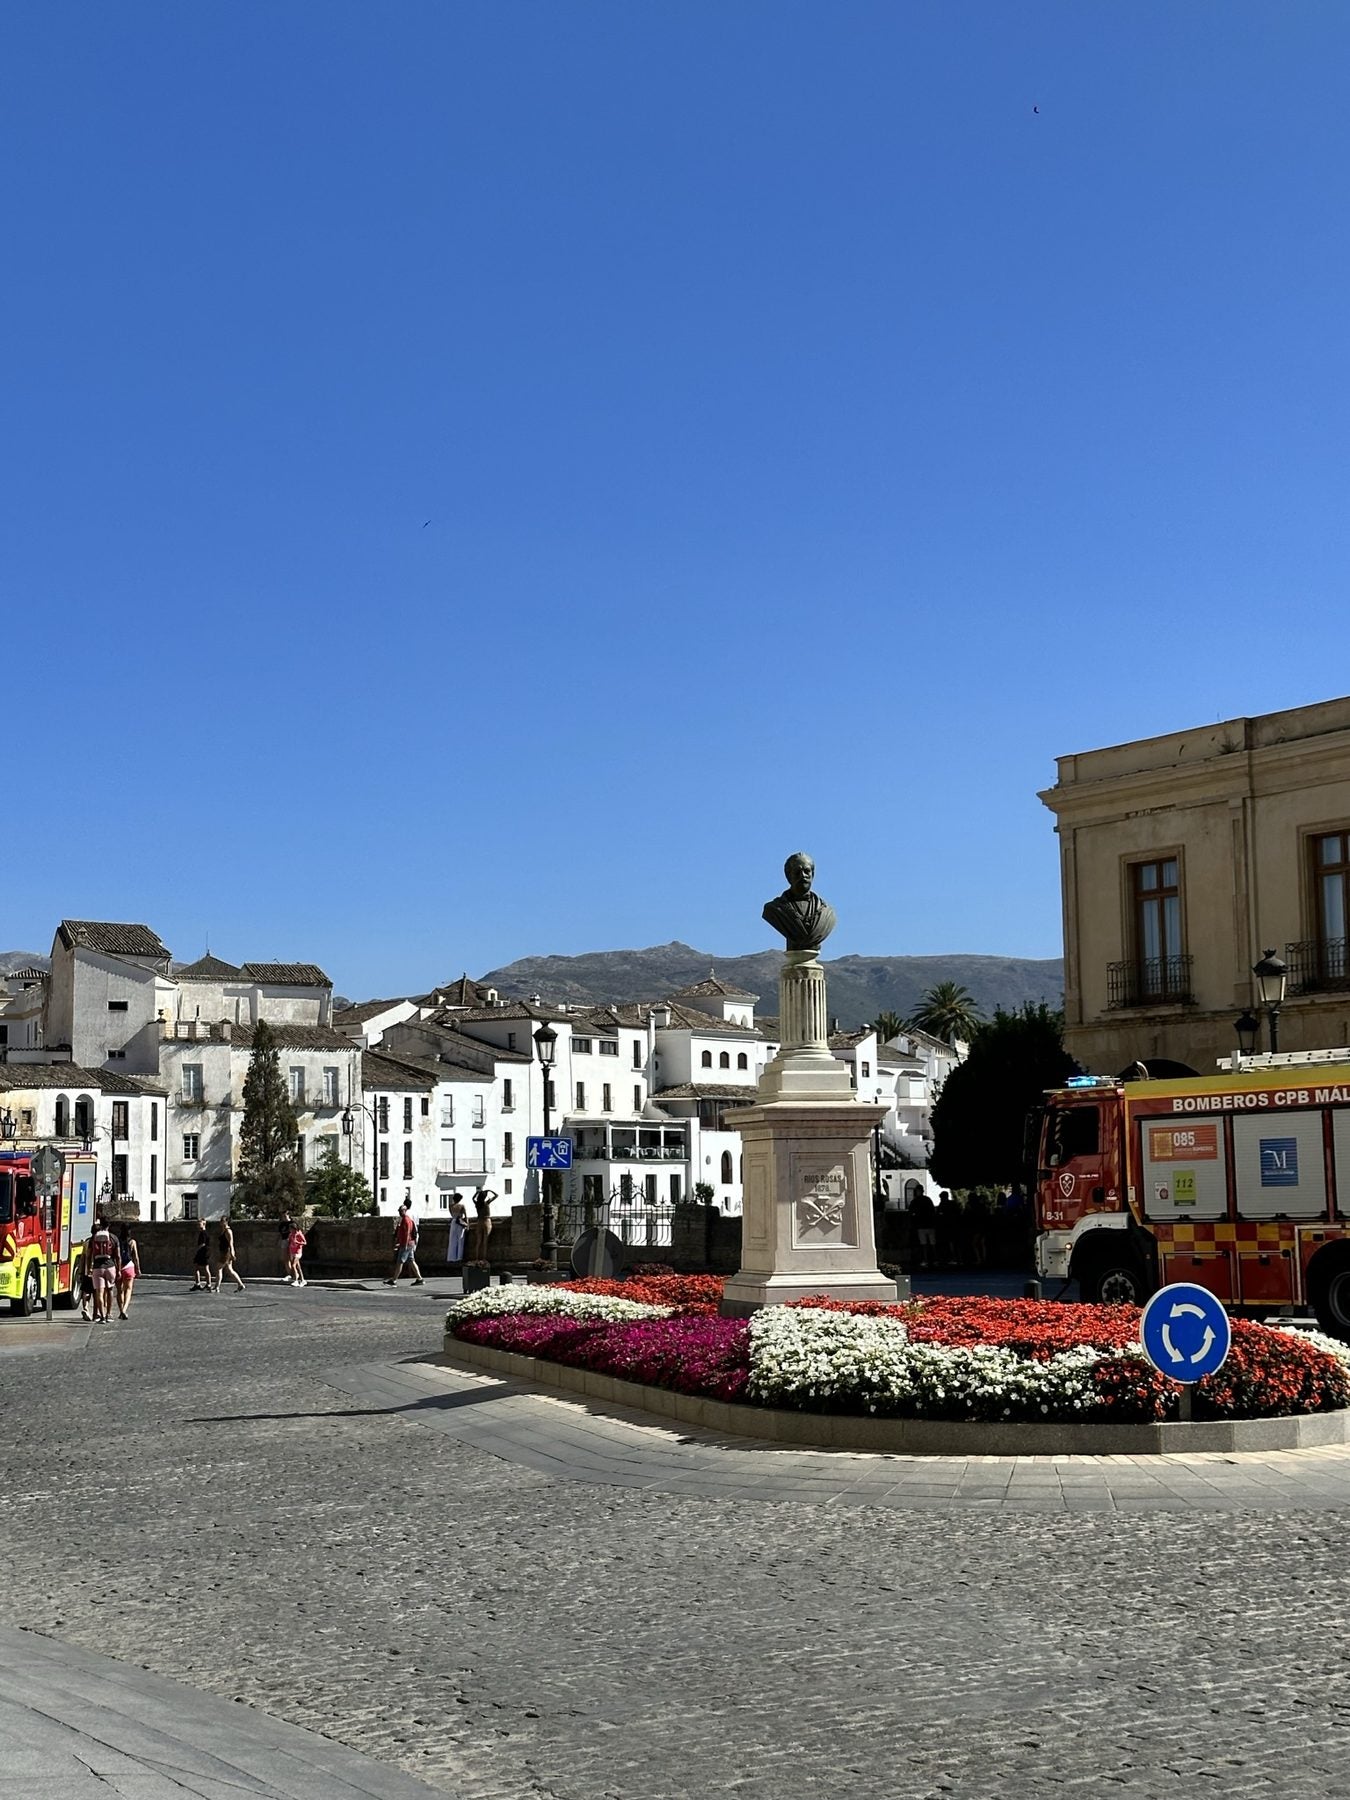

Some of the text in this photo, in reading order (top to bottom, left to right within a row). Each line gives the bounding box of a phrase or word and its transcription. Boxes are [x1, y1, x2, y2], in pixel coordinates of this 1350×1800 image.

[1173, 1093, 1269, 1112] BOMBEROS
[1274, 1090, 1310, 1105] CPB
[1173, 1132, 1195, 1147] 085
[1176, 1178, 1193, 1188] 112
[1046, 1211, 1063, 1221] B-31
